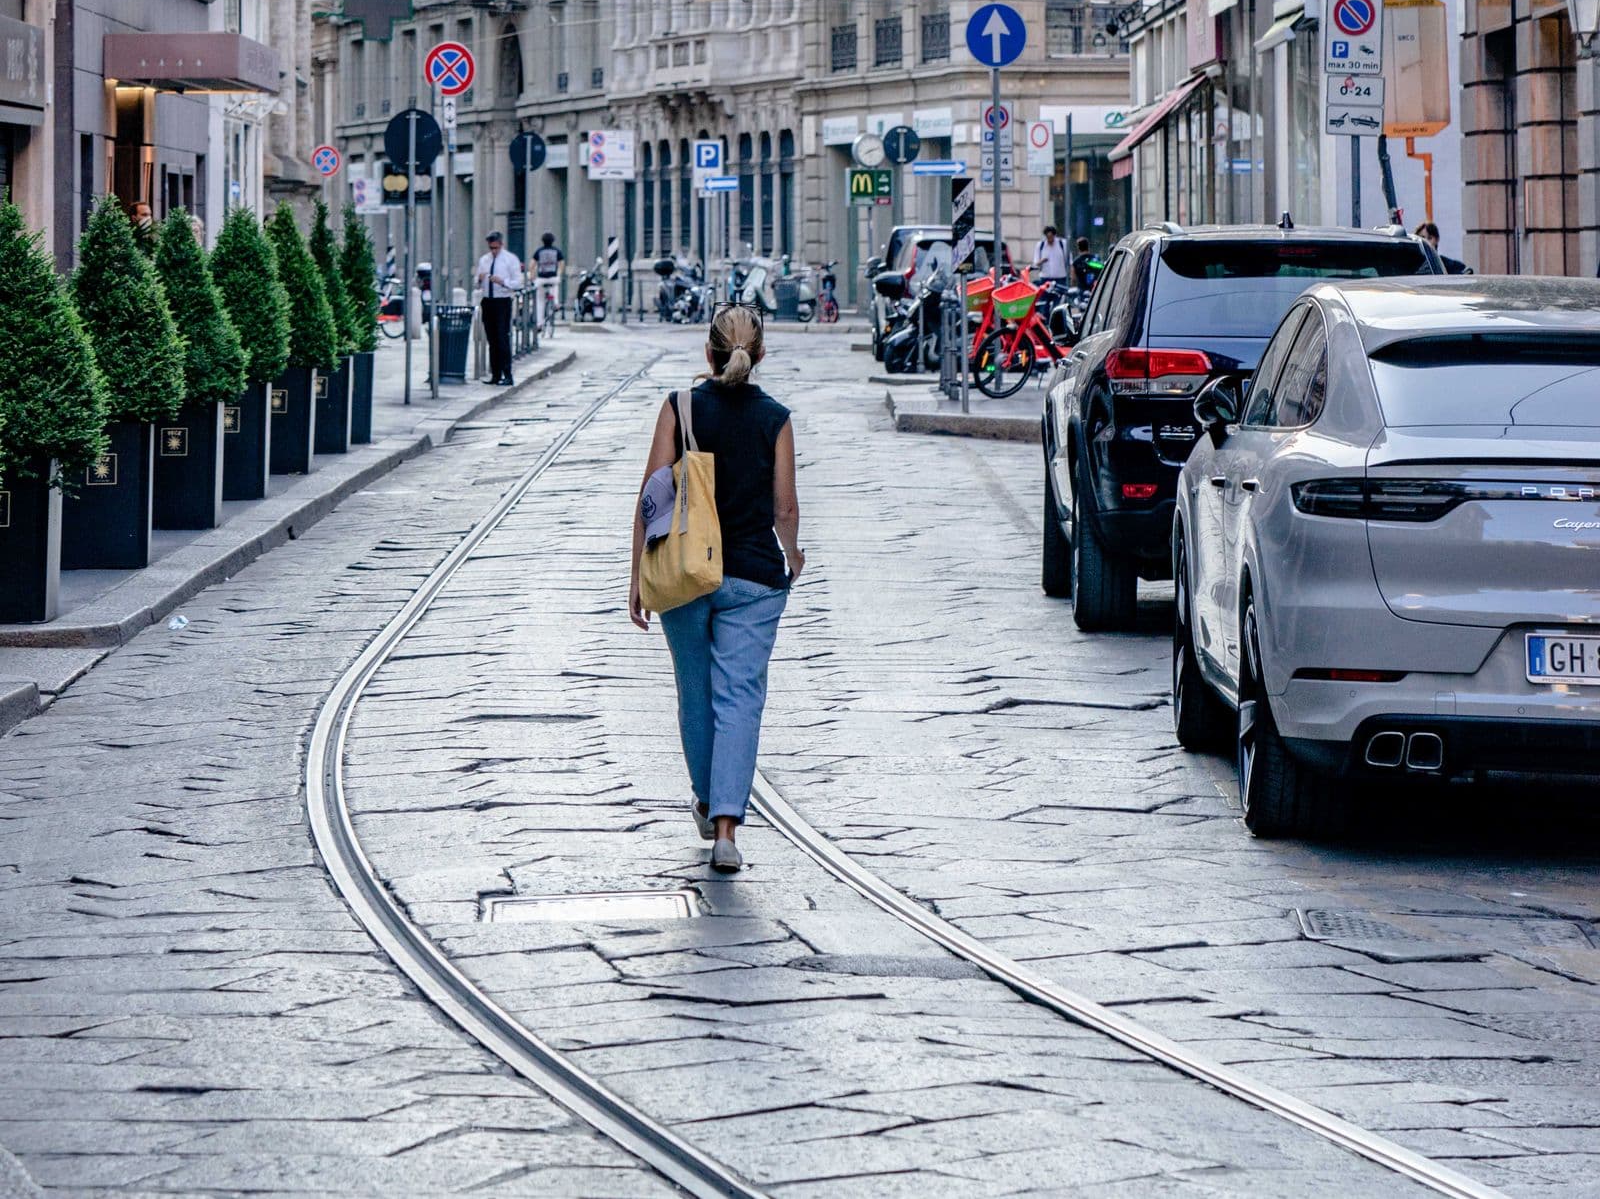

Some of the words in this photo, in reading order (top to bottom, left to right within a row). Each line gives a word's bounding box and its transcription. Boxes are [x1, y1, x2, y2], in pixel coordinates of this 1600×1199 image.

[1335, 43, 1346, 57] P
[1348, 61, 1361, 69] 30
[1362, 61, 1379, 70] min
[1340, 85, 1371, 96] 0-24
[700, 146, 716, 166] P
